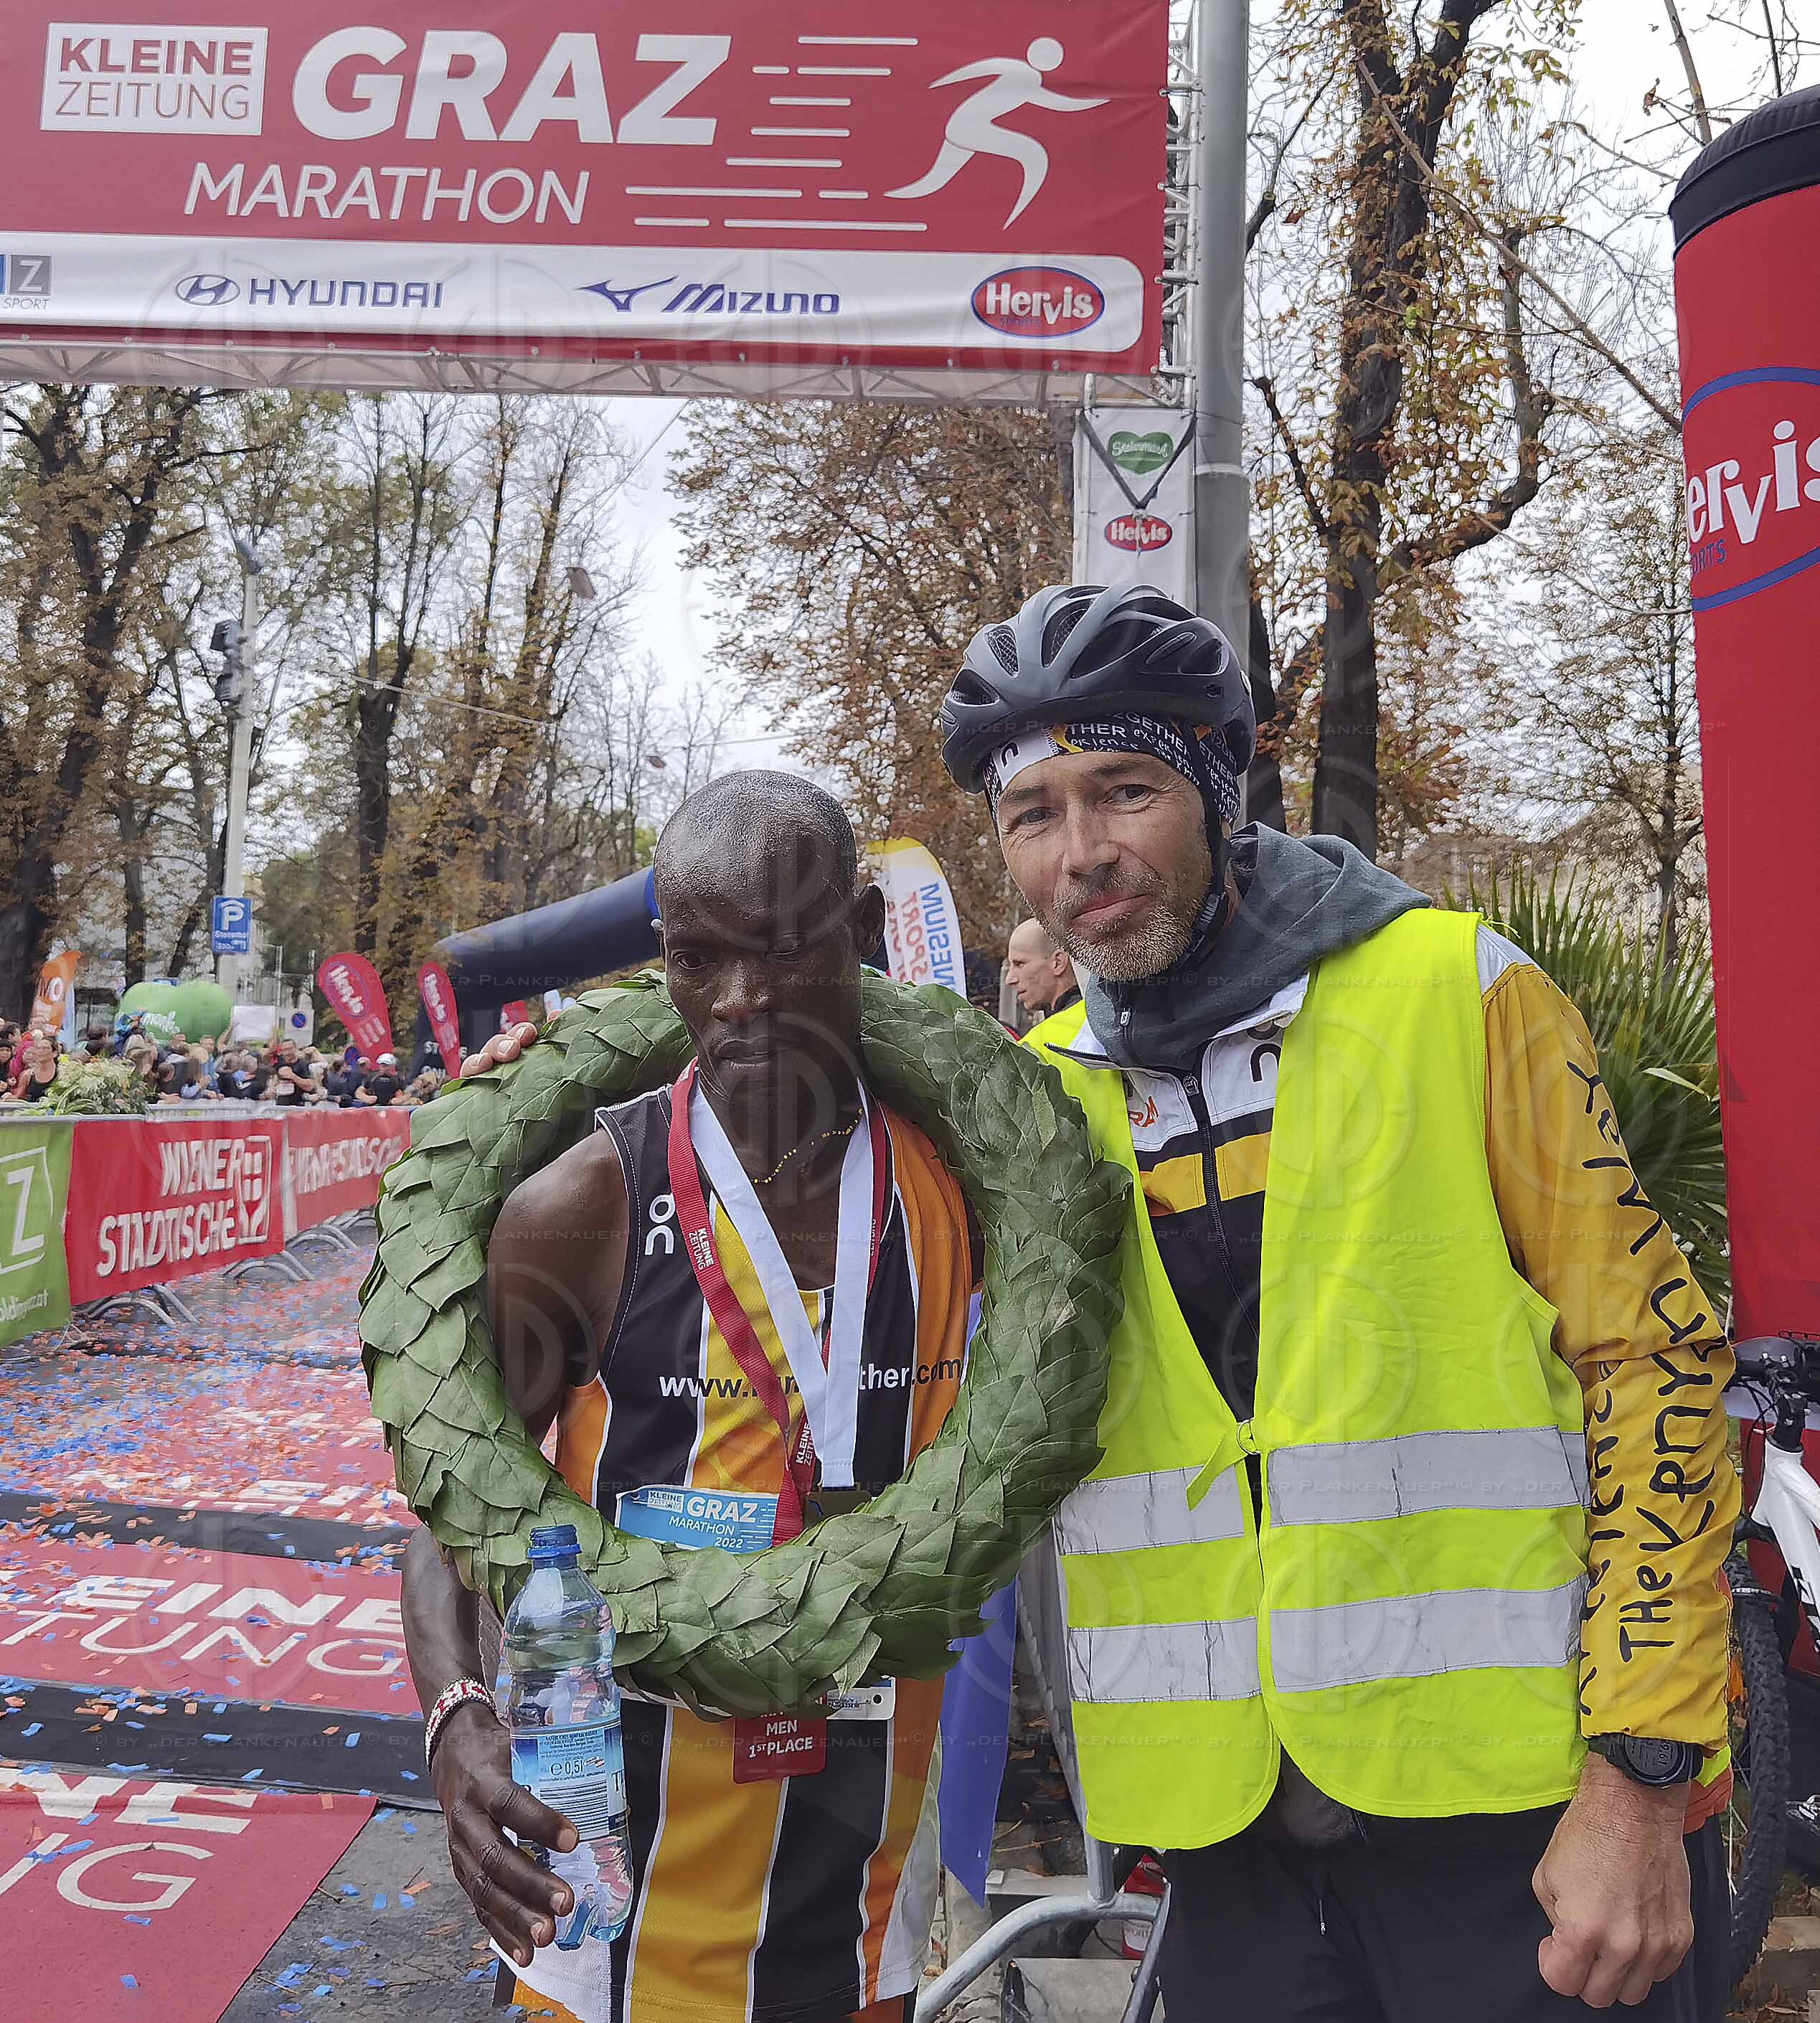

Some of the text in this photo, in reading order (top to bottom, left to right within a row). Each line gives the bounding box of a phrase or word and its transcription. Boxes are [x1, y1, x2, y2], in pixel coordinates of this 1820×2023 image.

[60, 37, 253, 76] KLEINE
[56, 80, 250, 120] ZEITUNG
[292, 25, 732, 146] GRAZ
[184, 162, 590, 225] MARATHON
[4, 298, 50, 310] SPORT
[248, 278, 444, 309] HYUNDAI
[662, 283, 841, 315] MIZUNO
[986, 281, 1095, 325] Hervis
[1111, 520, 1168, 544] Hervis
[223, 905, 245, 930] P
[689, 1230, 707, 1270] ZEITUNG
[697, 1227, 715, 1268] KLEINE
[649, 1491, 682, 1502] KLEINE
[687, 1496, 758, 1523] GRAZ
[669, 1515, 735, 1536] MARATHON
[715, 1537, 743, 1549] 2022
[765, 1718, 798, 1737] MEN
[748, 1735, 814, 1758] 1ST PLACE
